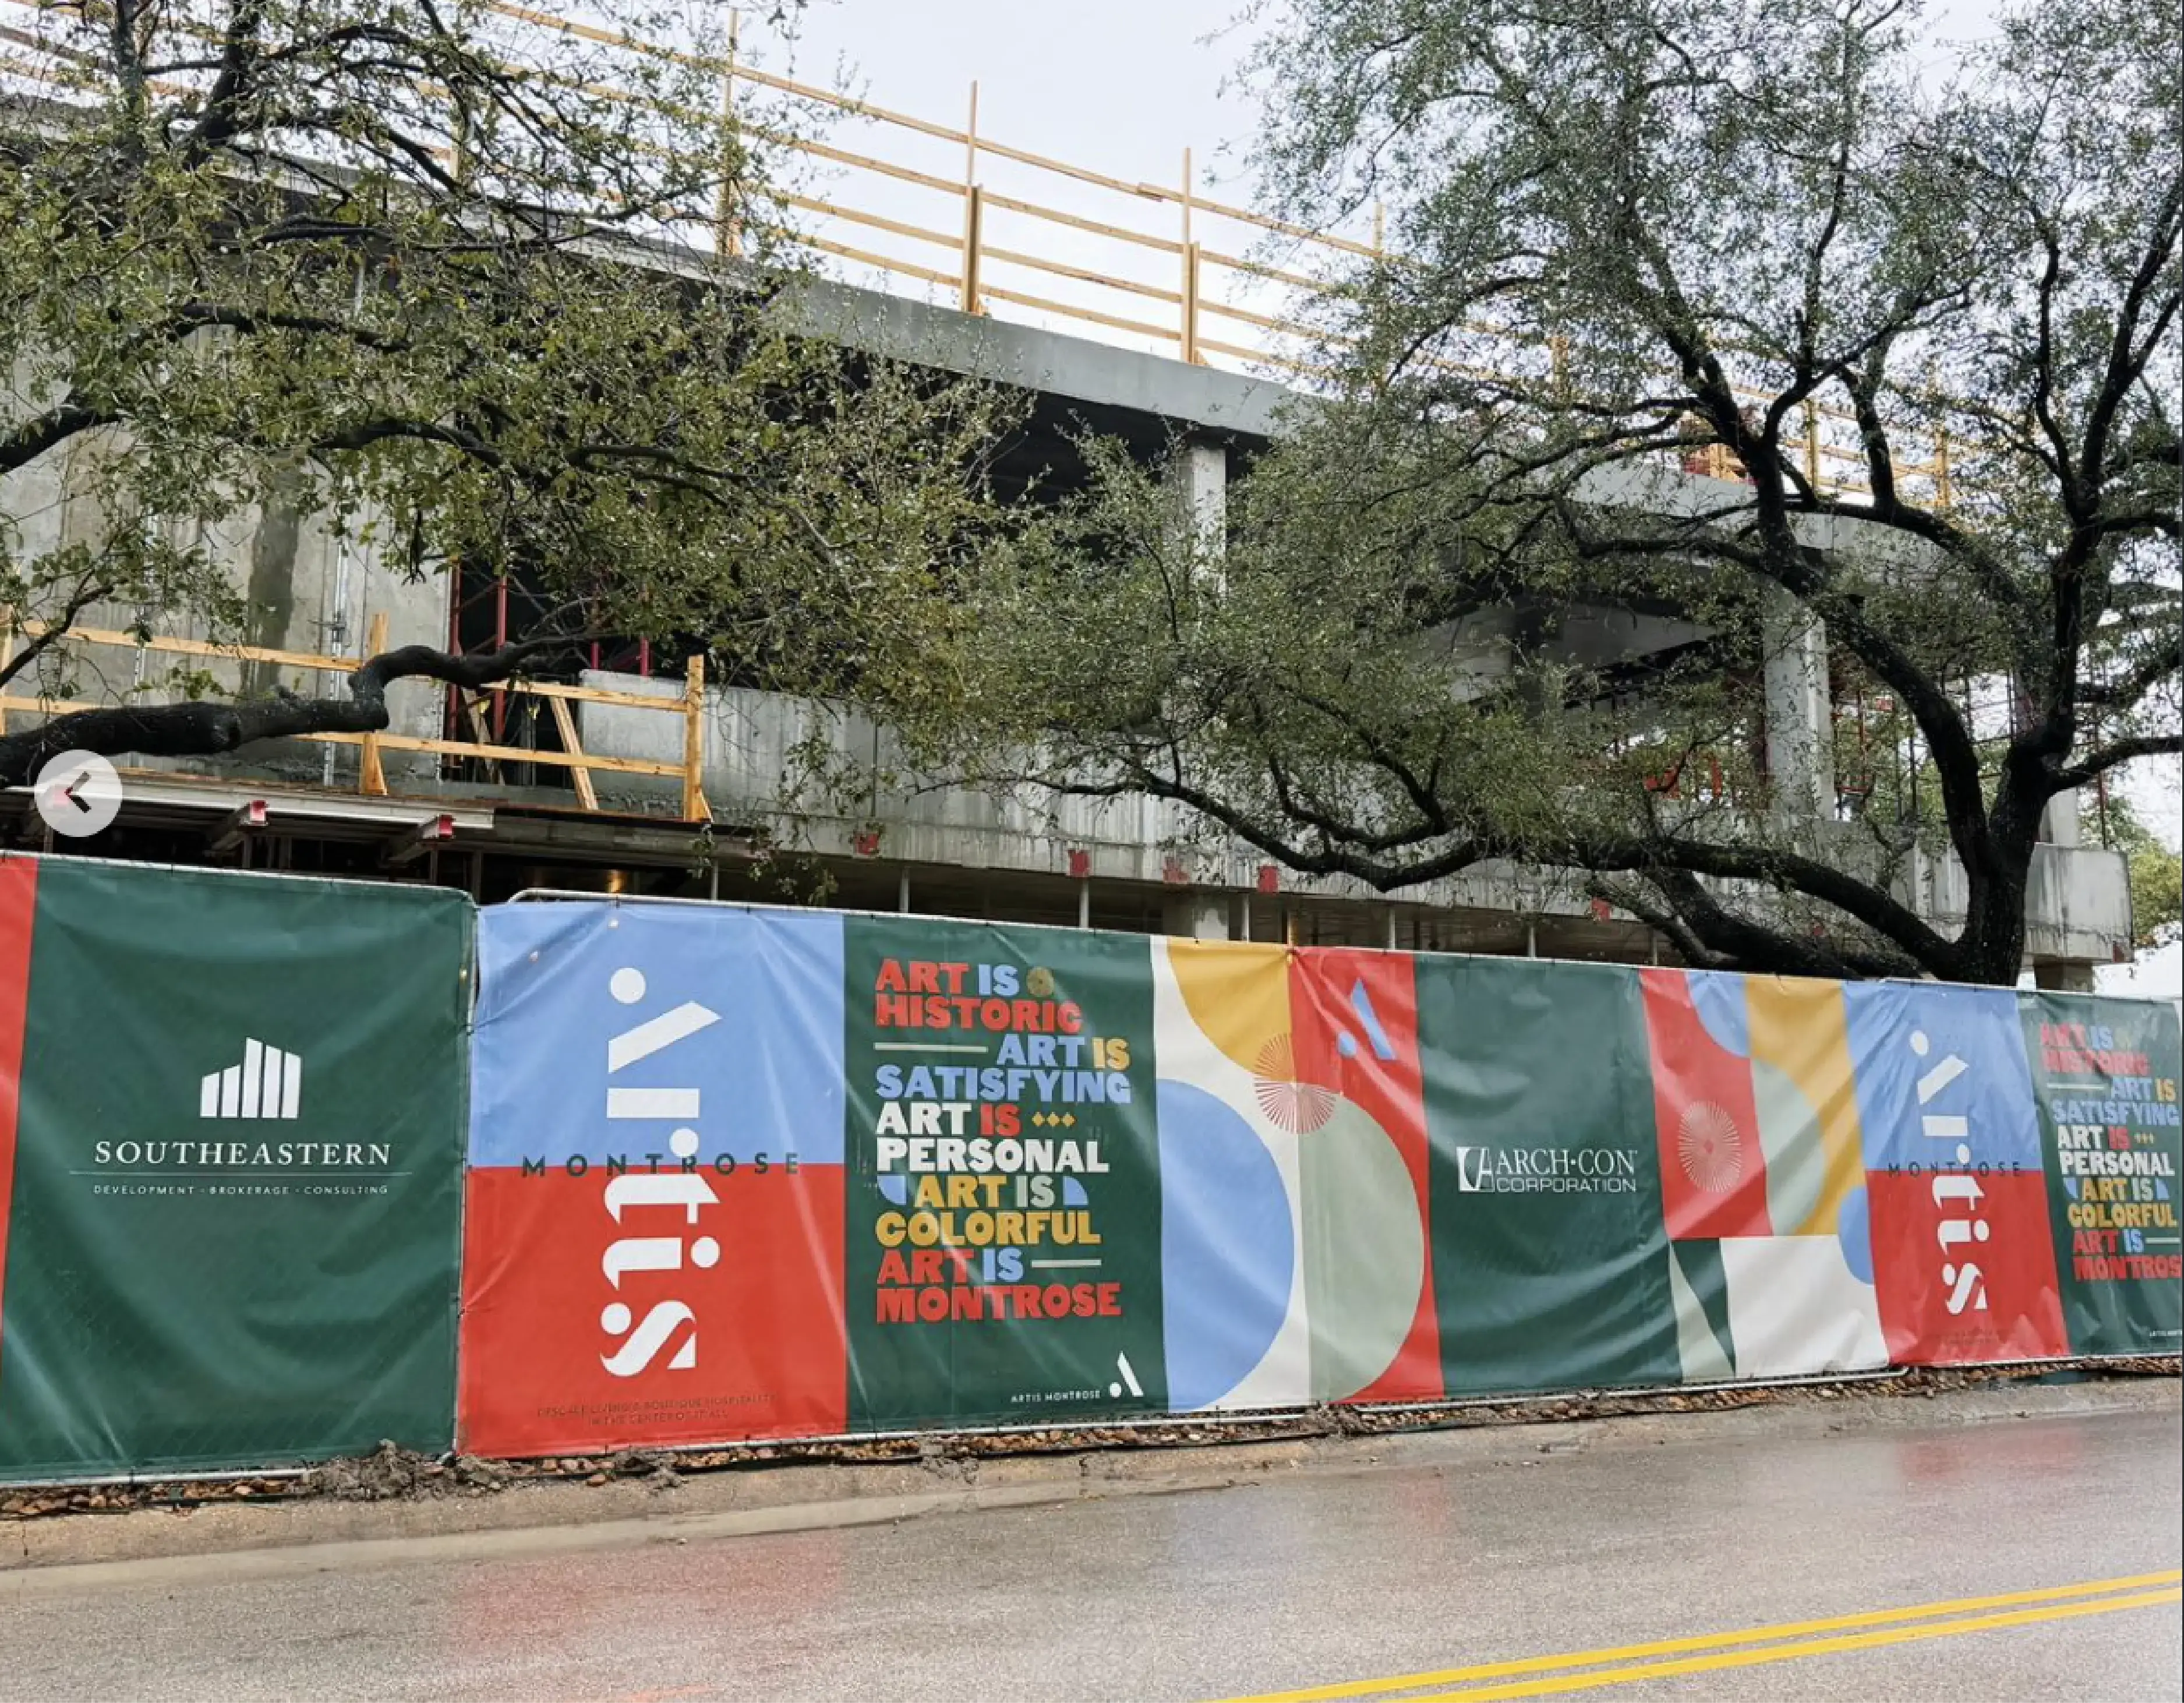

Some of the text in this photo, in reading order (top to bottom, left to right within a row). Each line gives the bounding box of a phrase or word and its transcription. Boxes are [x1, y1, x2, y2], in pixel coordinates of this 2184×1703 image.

[875, 959, 1020, 997] ART IS
[875, 993, 1083, 1034] HISTORIC
[2040, 1023, 2114, 1050] ART IS
[996, 1033, 1131, 1071] ART IS
[2044, 1049, 2150, 1076] HISTORIC
[875, 1065, 1132, 1104] SATISFYING
[2111, 1077, 2177, 1102] ART IS
[877, 1102, 1023, 1136] ART IS
[2052, 1100, 2181, 1126] SATISFYING
[2058, 1125, 2131, 1149] ART IS
[94, 1140, 391, 1165] SOUTHEASTERN
[522, 1153, 799, 1177] MONTROSE
[877, 1137, 1110, 1173] PERSONAL
[2059, 1150, 2175, 1176] PERSONAL
[1888, 1161, 2021, 1178] MONTROSE
[93, 1184, 388, 1196] DEVELOPMENT BROKERAGE CONSULTING
[914, 1175, 1055, 1208] ART IS
[1496, 1177, 1638, 1193] CORPORATION
[2082, 1177, 2154, 1201] ART IS
[875, 1210, 1102, 1246] COLORFUL
[2068, 1203, 2179, 1228] COLORFUL
[2073, 1228, 2144, 1256] ART IS
[877, 1248, 1025, 1285] ART IS
[877, 1282, 1122, 1324] MONTROSE
[1012, 1393, 1041, 1402] ARTIS
[1045, 1390, 1100, 1401] MONTROSE
